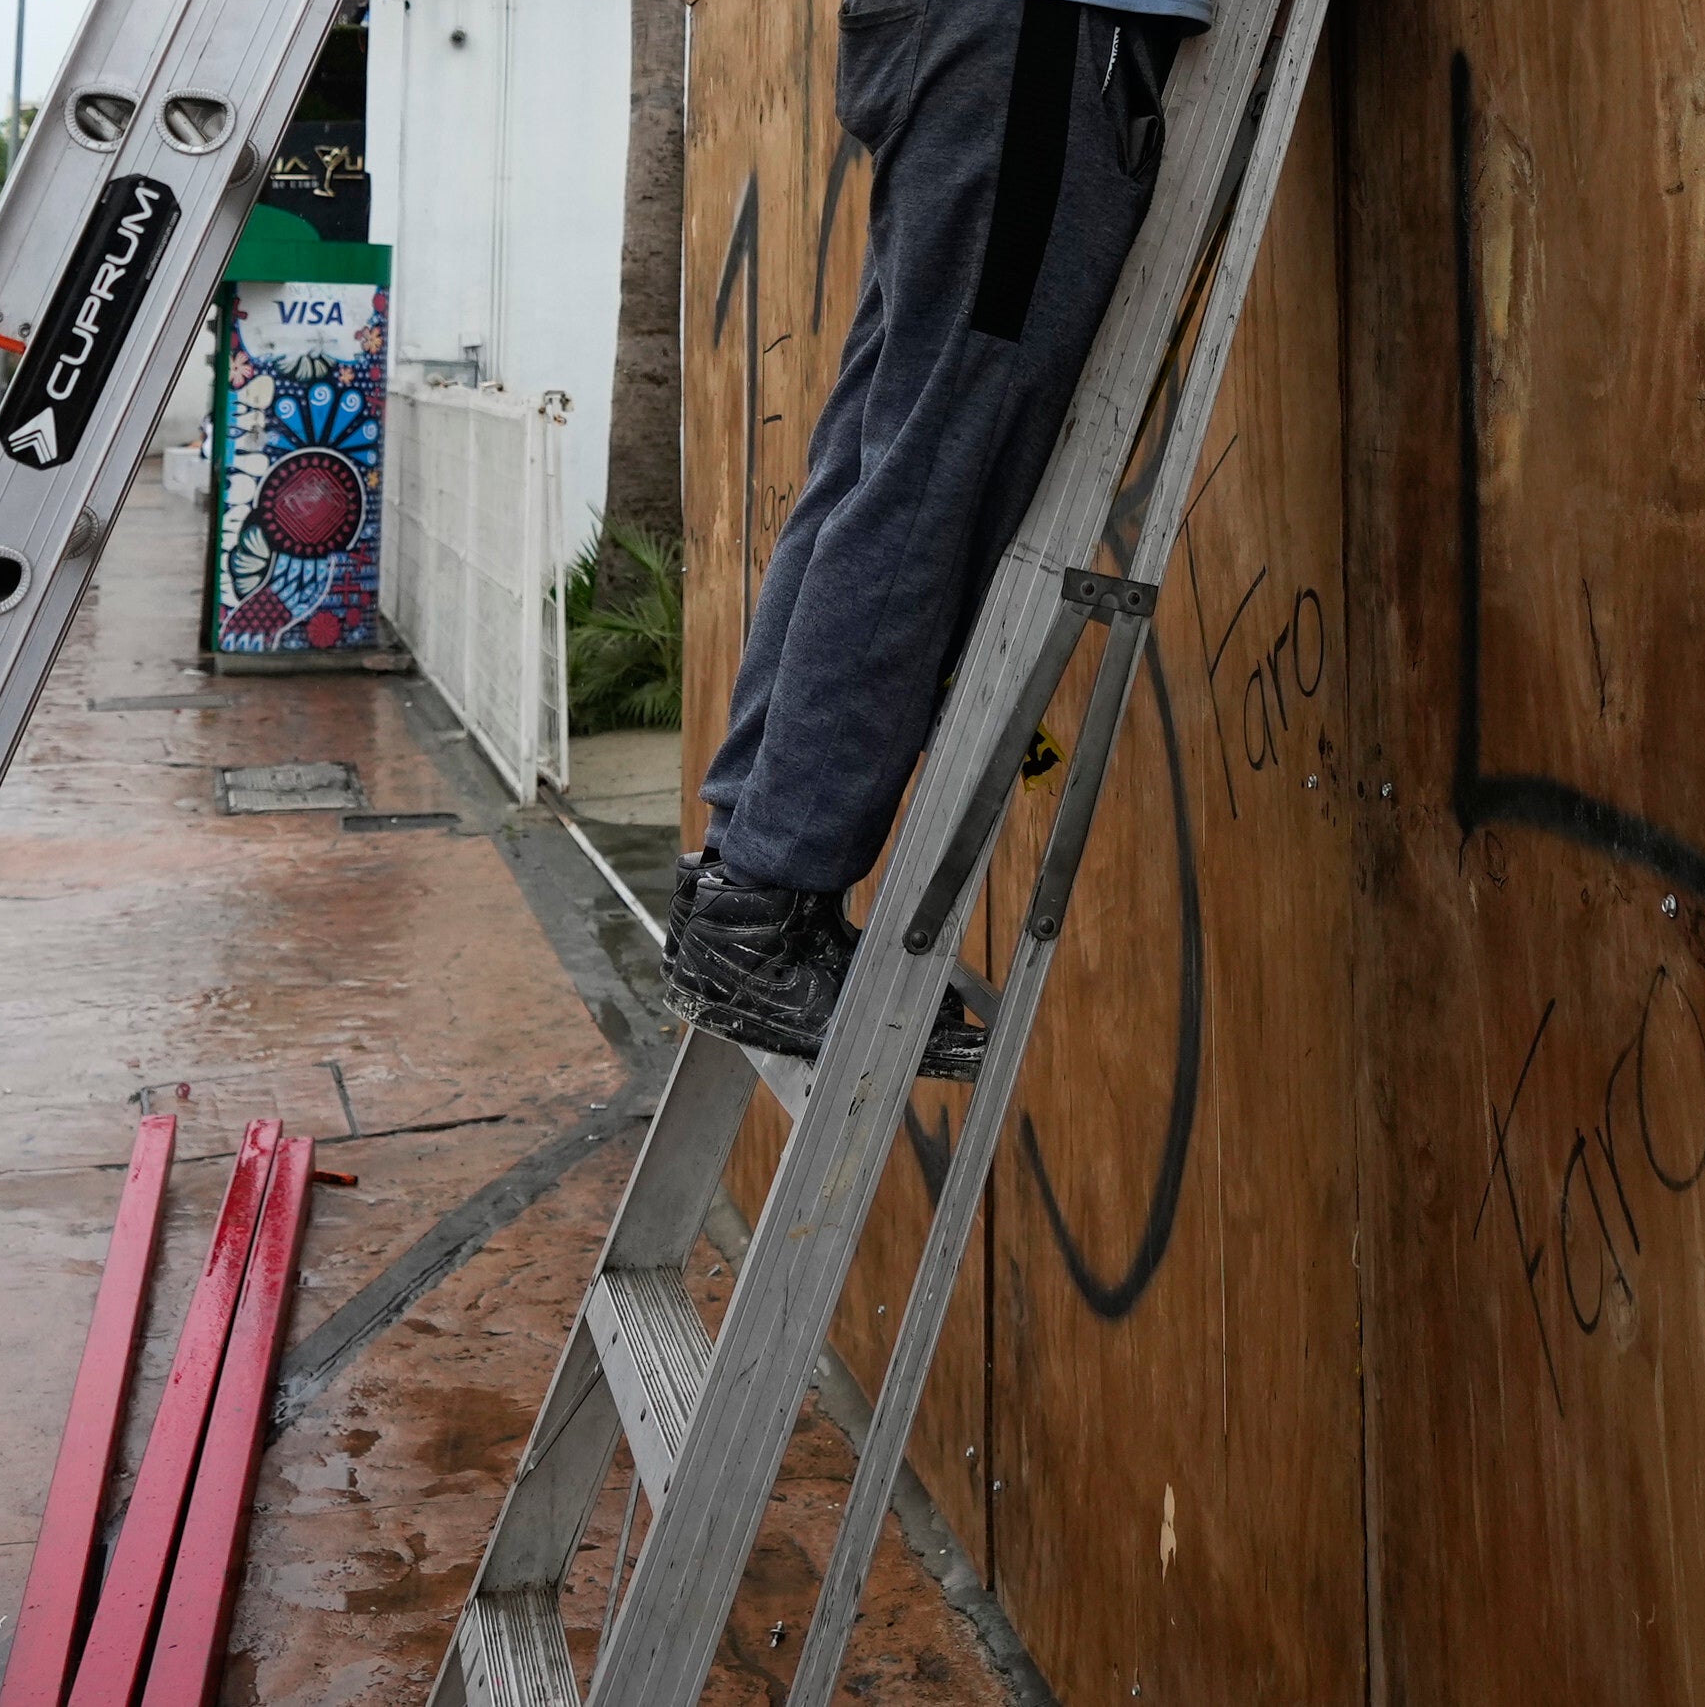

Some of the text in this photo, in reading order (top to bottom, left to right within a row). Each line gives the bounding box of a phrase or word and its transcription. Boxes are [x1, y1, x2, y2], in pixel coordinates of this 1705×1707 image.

[46, 186, 160, 401] CUPRUM
[273, 300, 344, 326] VISA
[1175, 432, 1325, 821] Faro
